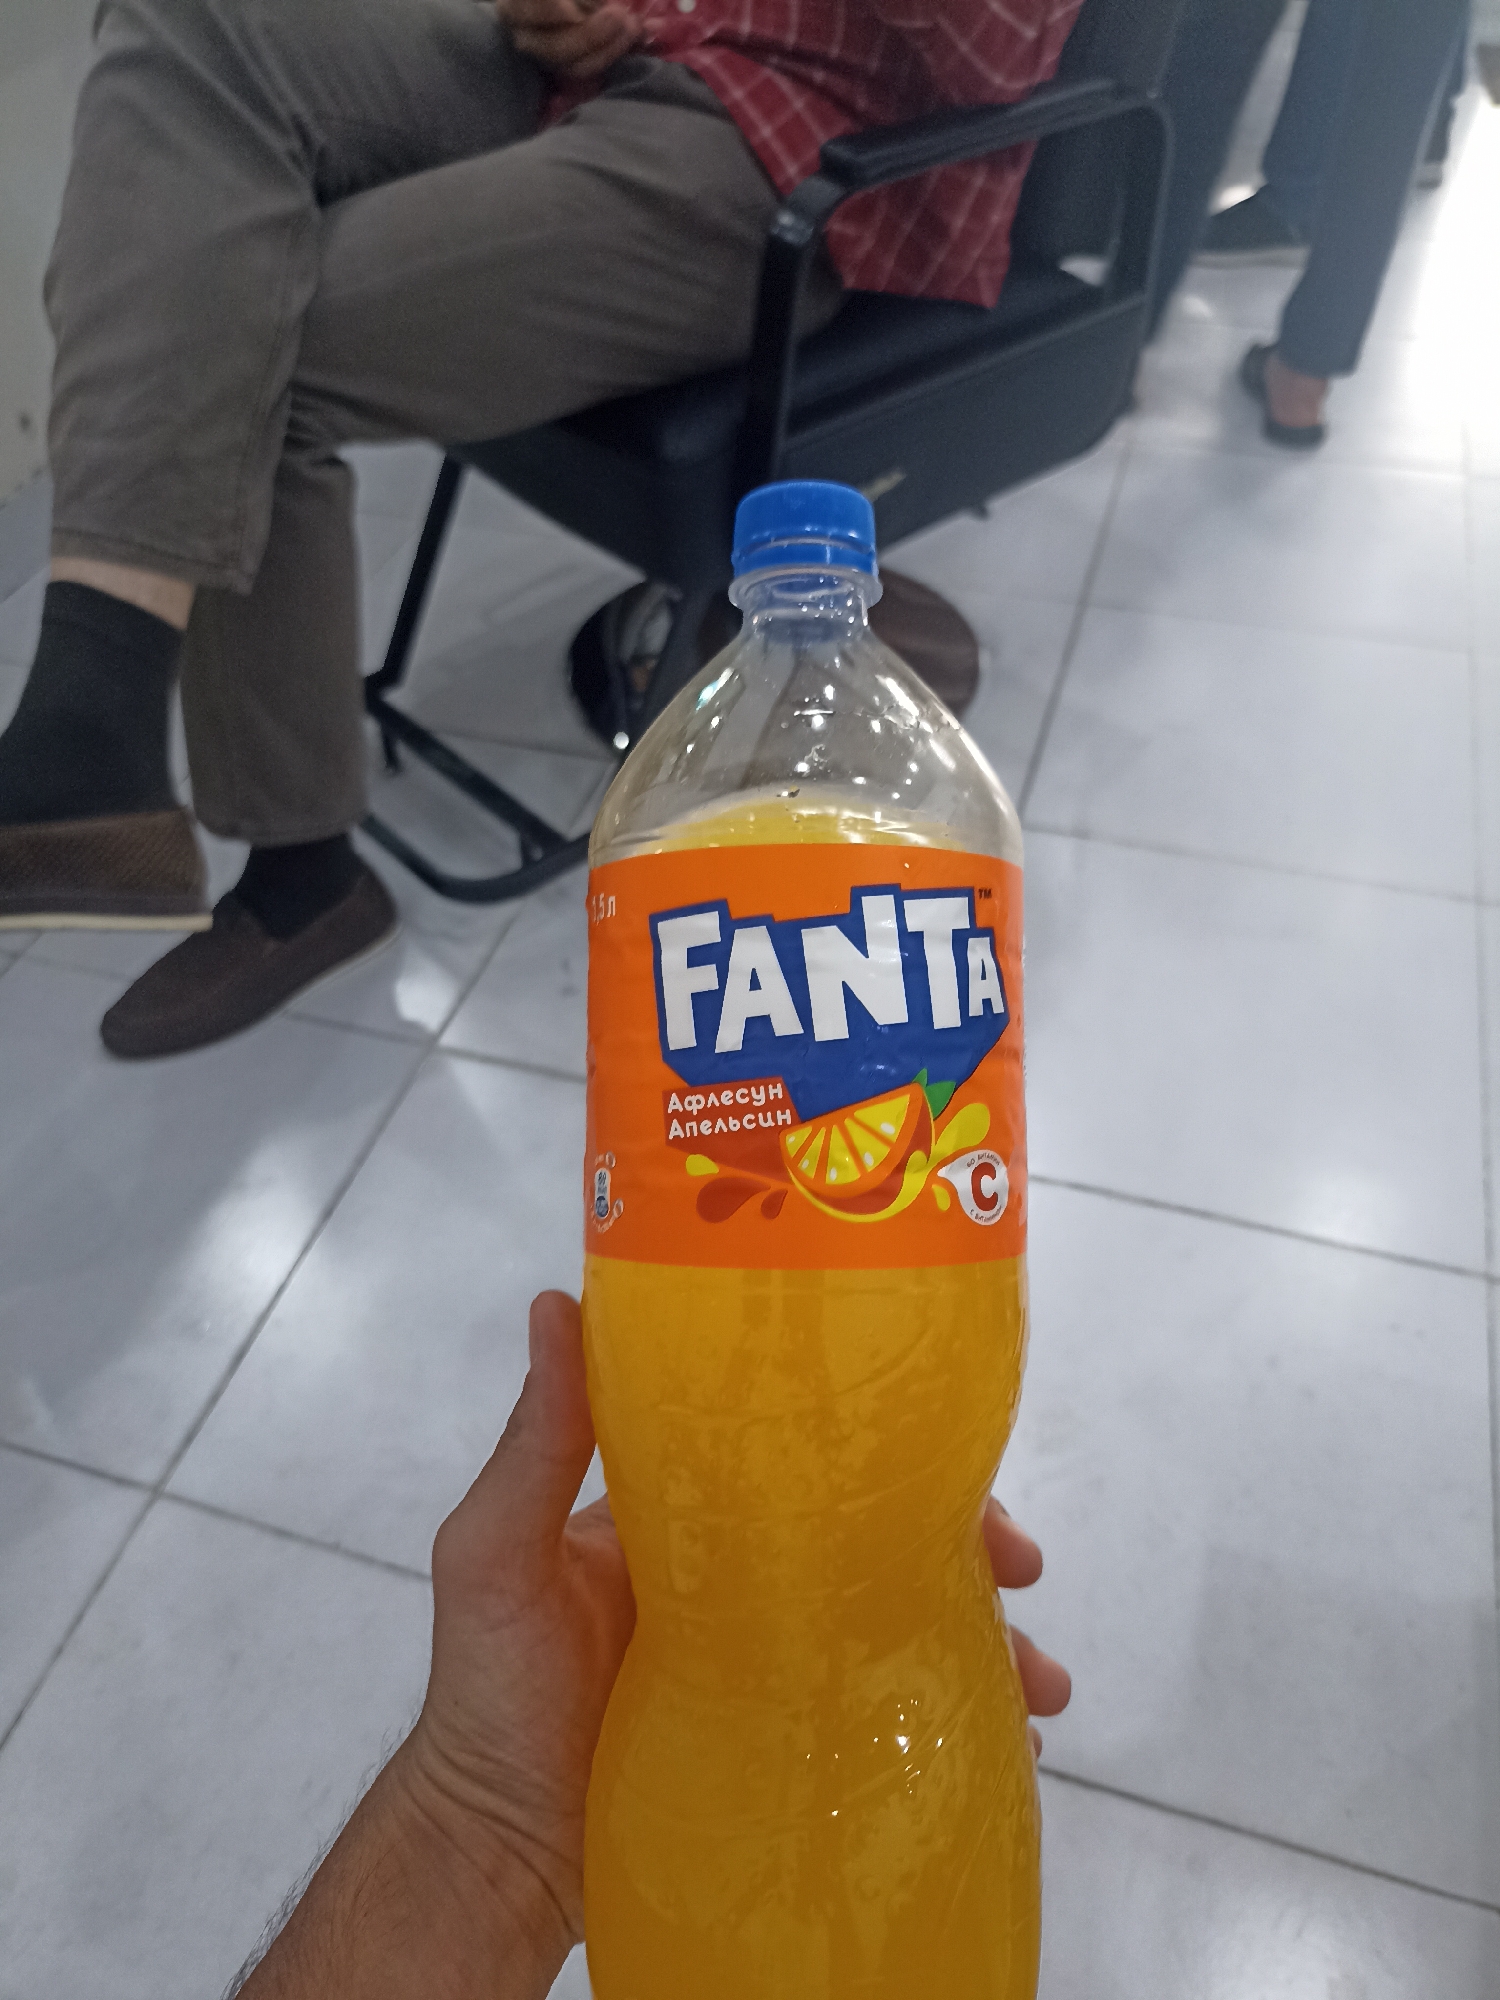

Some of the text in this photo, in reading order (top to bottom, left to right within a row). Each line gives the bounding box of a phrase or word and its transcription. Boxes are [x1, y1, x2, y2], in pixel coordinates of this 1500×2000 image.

[657, 894, 1005, 1053] FANTA
[667, 1083, 783, 1116] Афлесун
[668, 1109, 792, 1140] Апельсин
